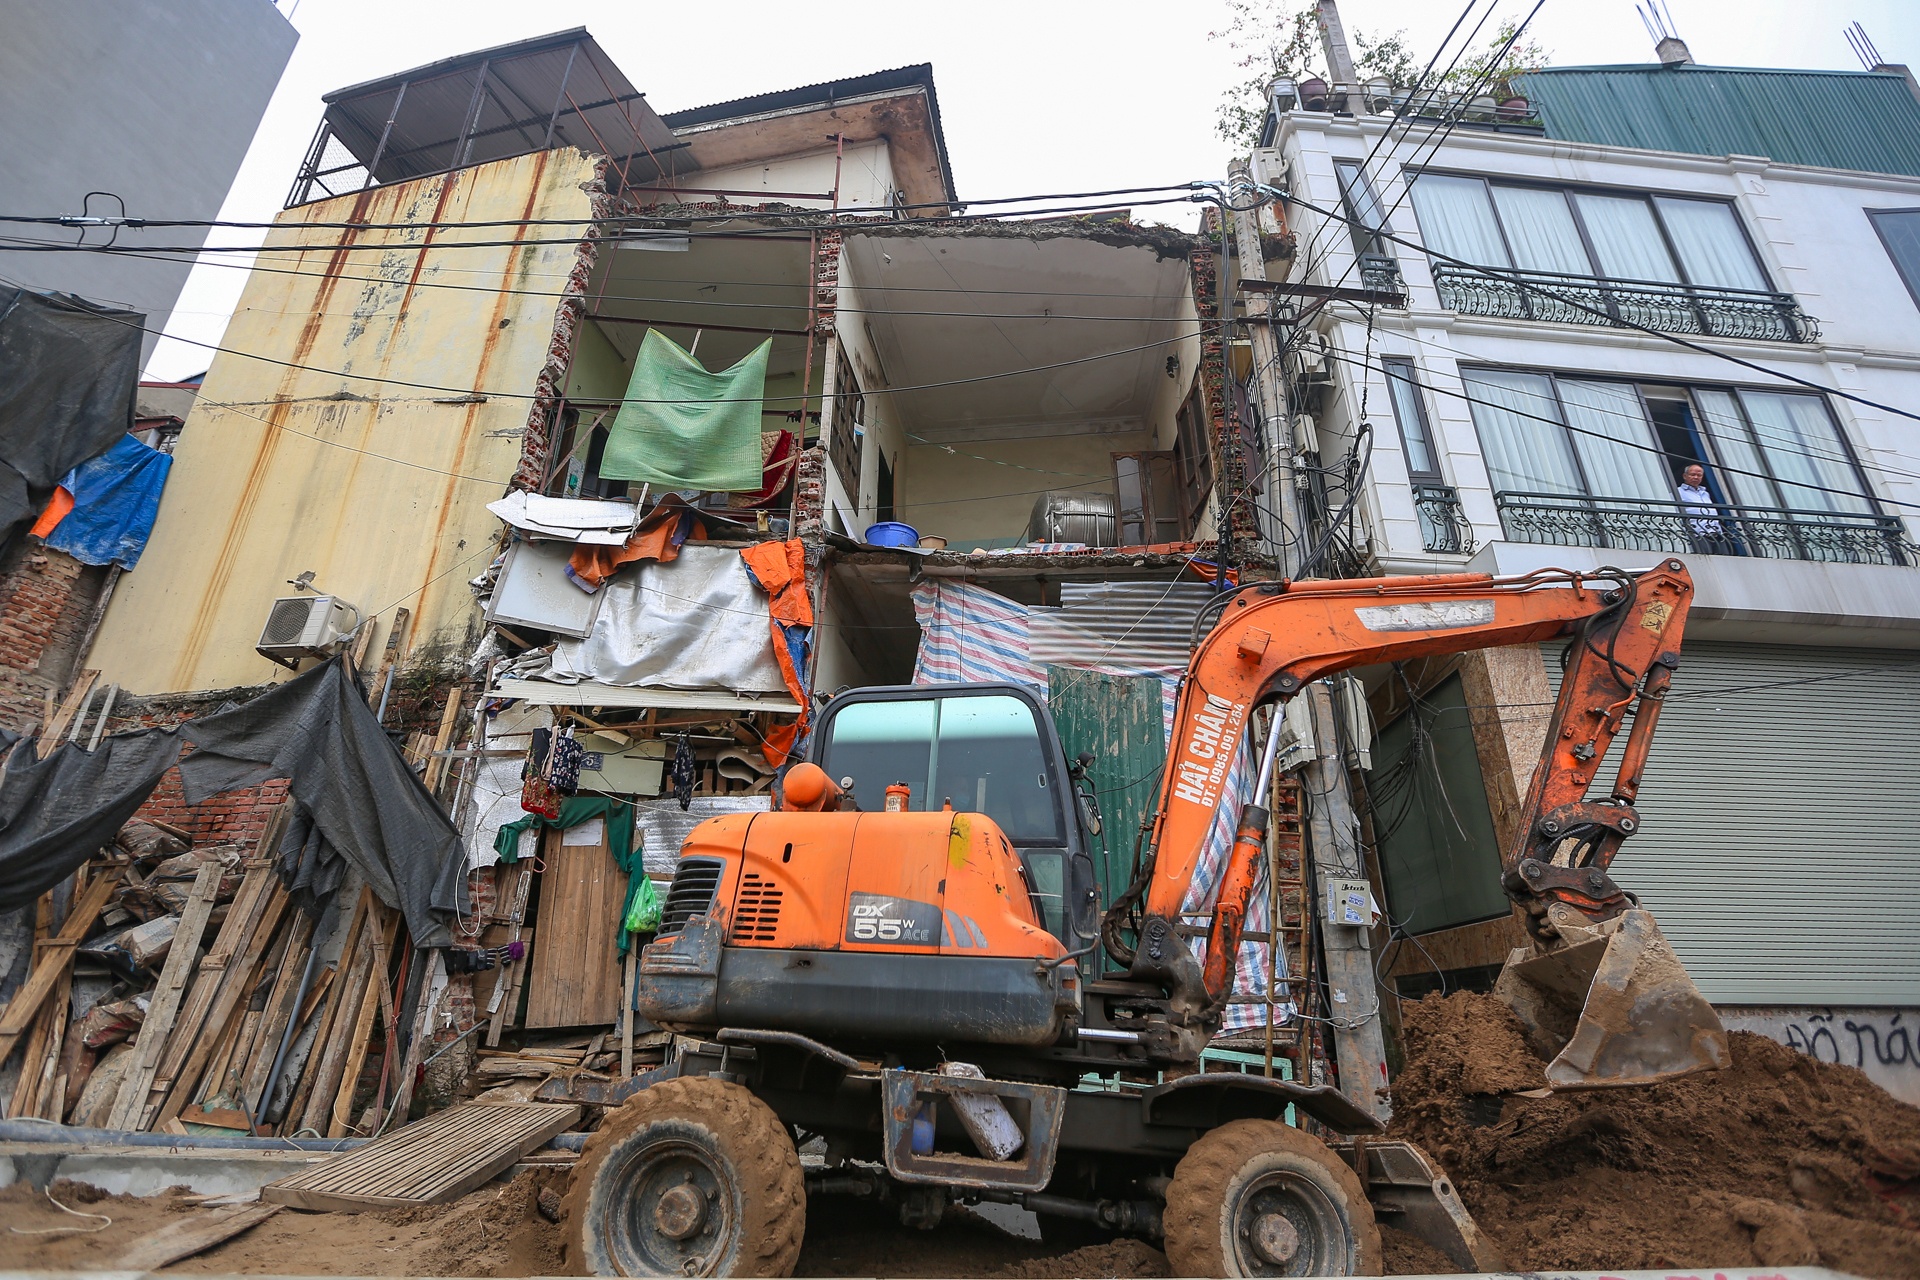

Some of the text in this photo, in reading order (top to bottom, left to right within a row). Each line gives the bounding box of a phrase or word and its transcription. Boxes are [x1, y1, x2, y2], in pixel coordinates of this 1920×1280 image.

[1174, 693, 1233, 804] HẢI CHÂM
[853, 902, 894, 918] DX
[1844, 1012, 1920, 1068] rá
